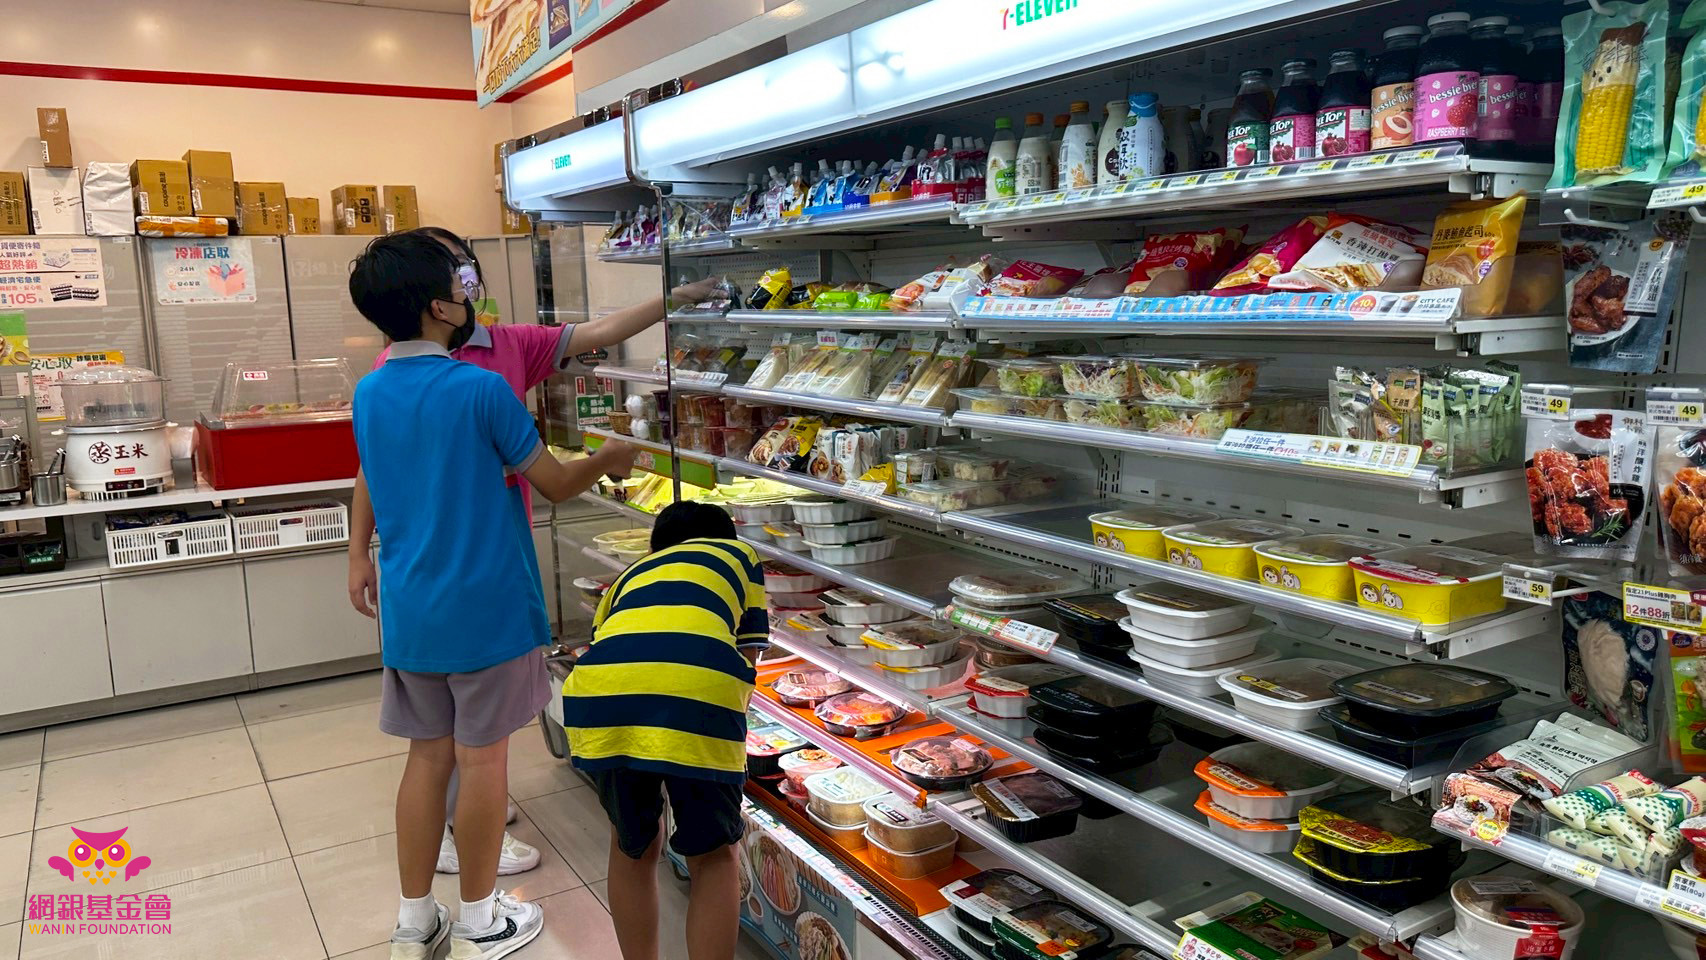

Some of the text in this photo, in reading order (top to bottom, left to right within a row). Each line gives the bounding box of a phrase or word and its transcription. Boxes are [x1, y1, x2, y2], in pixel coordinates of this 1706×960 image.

[1398, 91, 1414, 103] bye
[1429, 87, 1461, 103] bessie
[1325, 111, 1342, 122] TOP
[1235, 126, 1250, 135] TOP
[1276, 120, 1290, 131] TOP
[1427, 127, 1459, 138] RASPBERRY
[1689, 185, 1703, 193] 49
[175, 246, 230, 259] 冷凍店取
[1550, 399, 1563, 408] 49
[1682, 406, 1697, 415] 49
[1531, 583, 1544, 593] 59
[1581, 864, 1596, 874] 49
